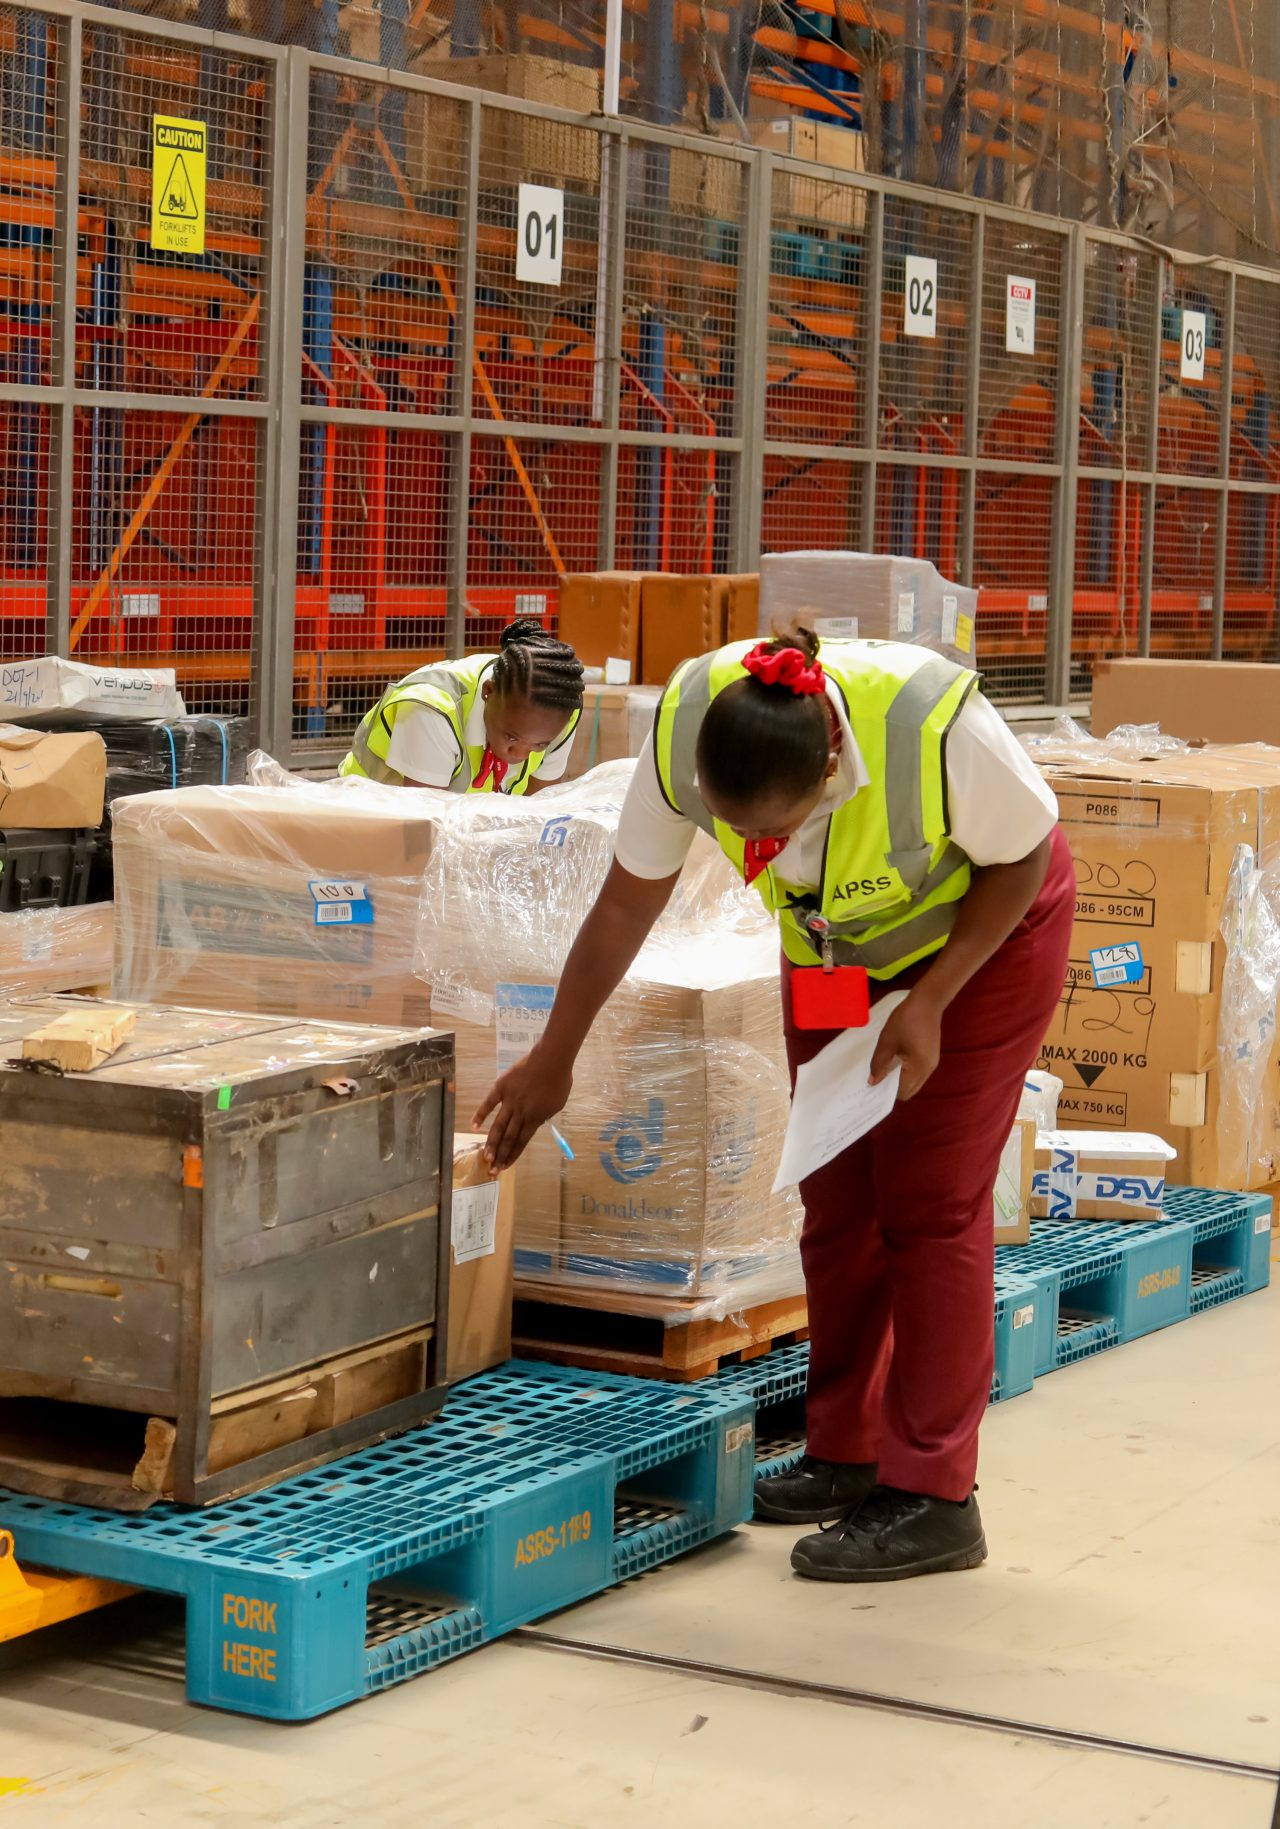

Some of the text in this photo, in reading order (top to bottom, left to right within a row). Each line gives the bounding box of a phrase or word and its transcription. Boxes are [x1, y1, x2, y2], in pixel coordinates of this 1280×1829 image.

[158, 128, 202, 149] CAUTION
[160, 221, 196, 234] FORKLIFTS
[525, 211, 557, 260] 01
[166, 236, 188, 247] IN USE
[910, 277, 933, 316] 02
[1013, 285, 1029, 300] CCTV
[1185, 328, 1203, 362] 03
[1086, 803, 1118, 817] P086
[831, 876, 892, 902] APSS
[1107, 904, 1144, 917] 95CM
[1041, 1045, 1148, 1068] MAX 2000 KG
[1057, 1099, 1124, 1116] MAX 750 KG
[1096, 1176, 1165, 1200] DSV
[581, 1193, 680, 1220] Donaldson
[223, 1593, 277, 1634] FORK
[223, 1641, 277, 1681] HERE
